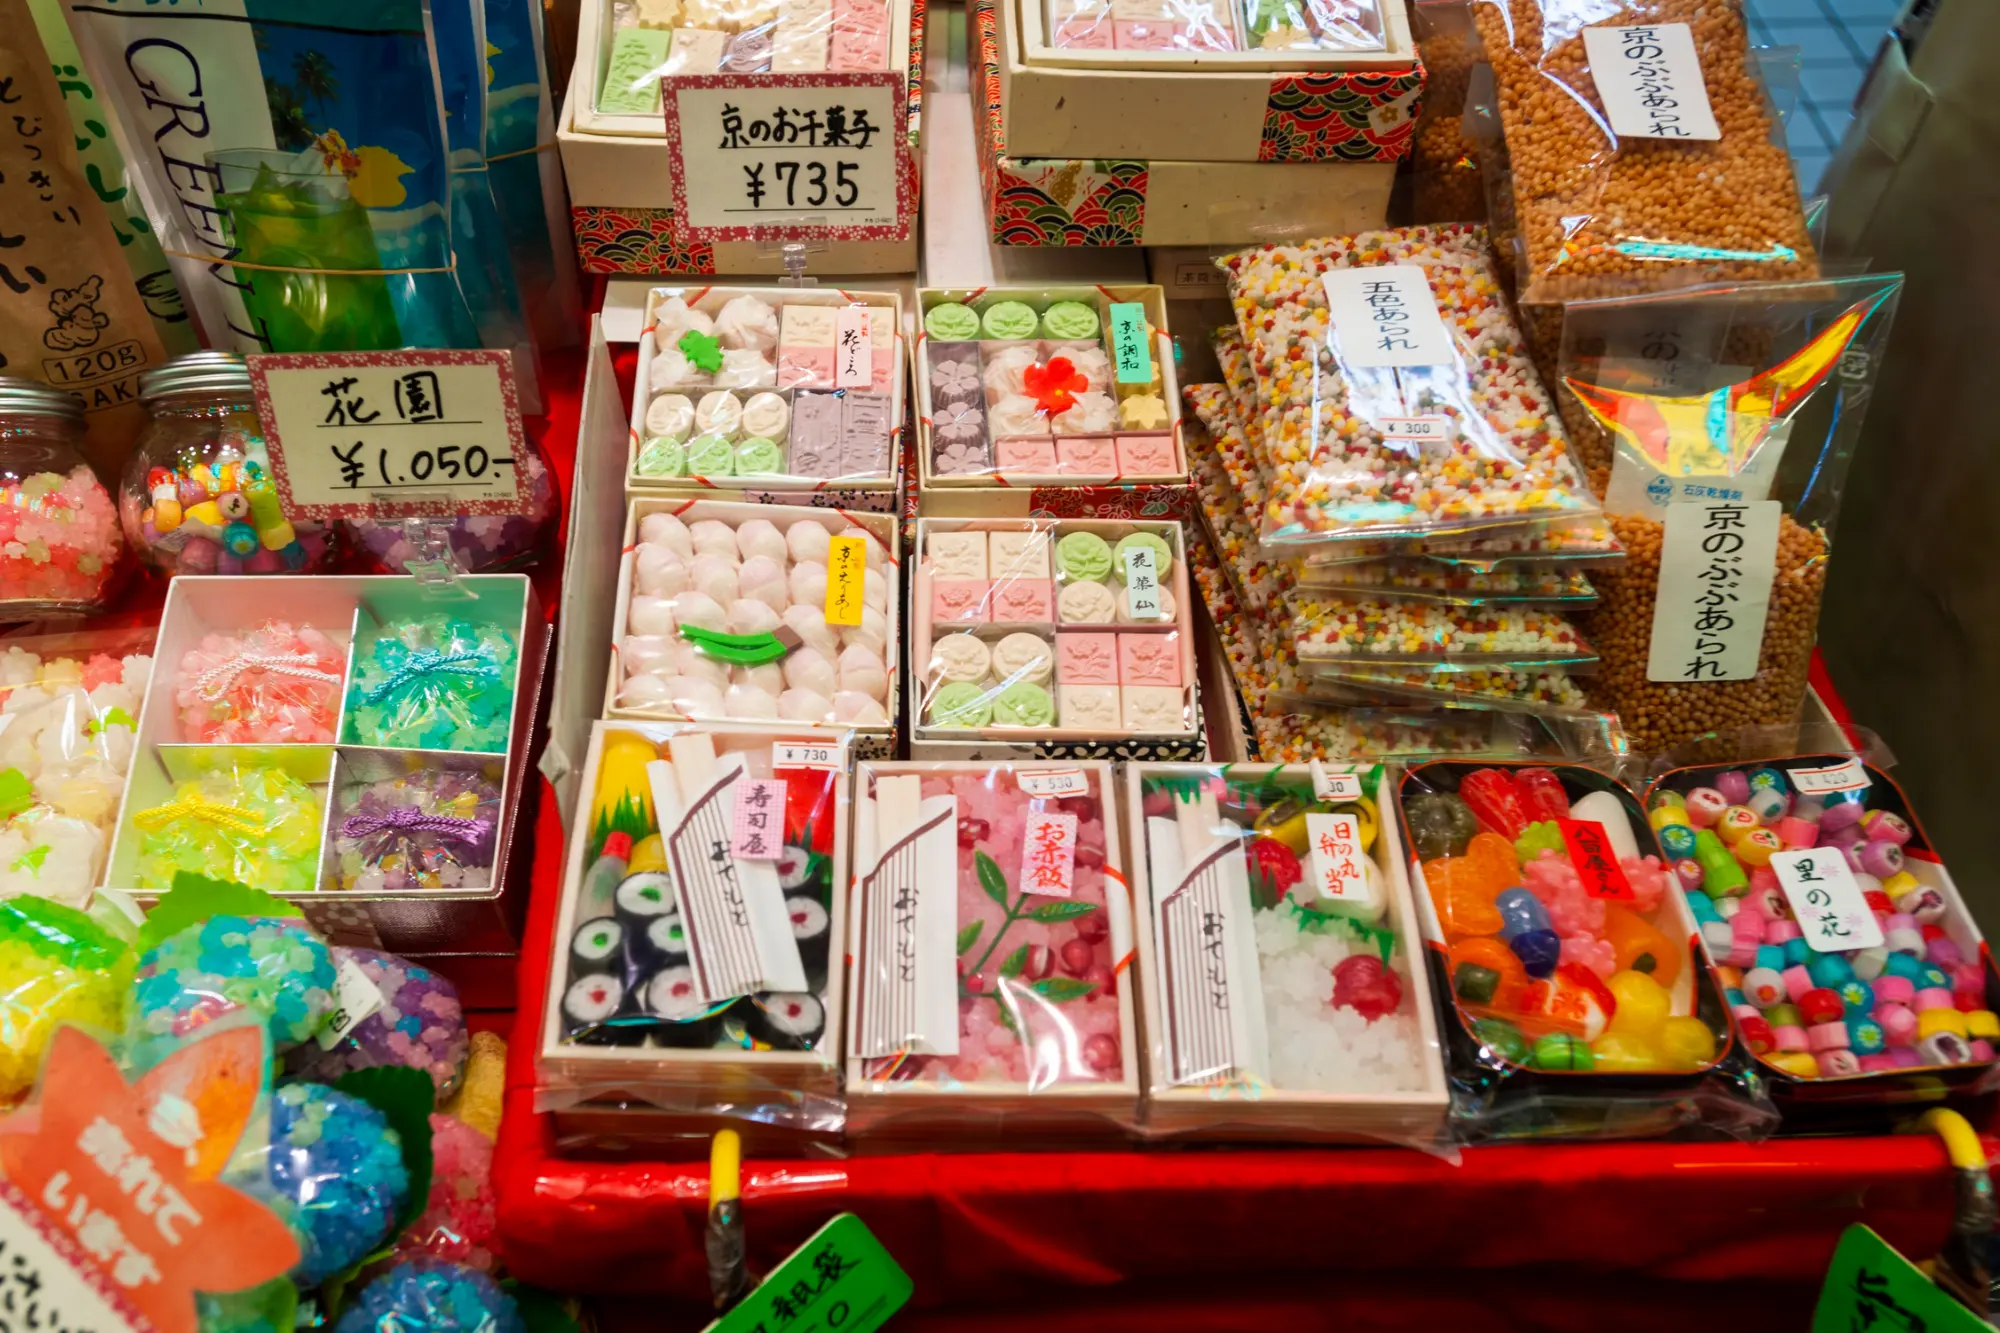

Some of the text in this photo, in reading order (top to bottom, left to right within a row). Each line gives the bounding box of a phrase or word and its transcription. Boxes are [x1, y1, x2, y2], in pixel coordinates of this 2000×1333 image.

[1618, 27, 1691, 136] 京のぶぶあられ
[720, 103, 880, 149] 京のお干菓子
[125, 38, 257, 297] GREEN
[743, 161, 859, 208] ¥735
[1361, 281, 1420, 351] 五色あられ
[54, 345, 137, 380] 120g
[321, 373, 443, 426] 花園
[1405, 422, 1431, 434] 300
[1683, 503, 1750, 679] 京のぶぶあられ
[803, 749, 828, 762] 730
[1048, 776, 1074, 791] 530
[739, 784, 773, 855] 寿司屋
[1334, 821, 1360, 879] 日の丸
[1030, 822, 1069, 890] お赤飯
[1317, 831, 1344, 896] 弁当
[1793, 857, 1852, 938] 里の花
[745, 1242, 864, 1333] 紙袋
